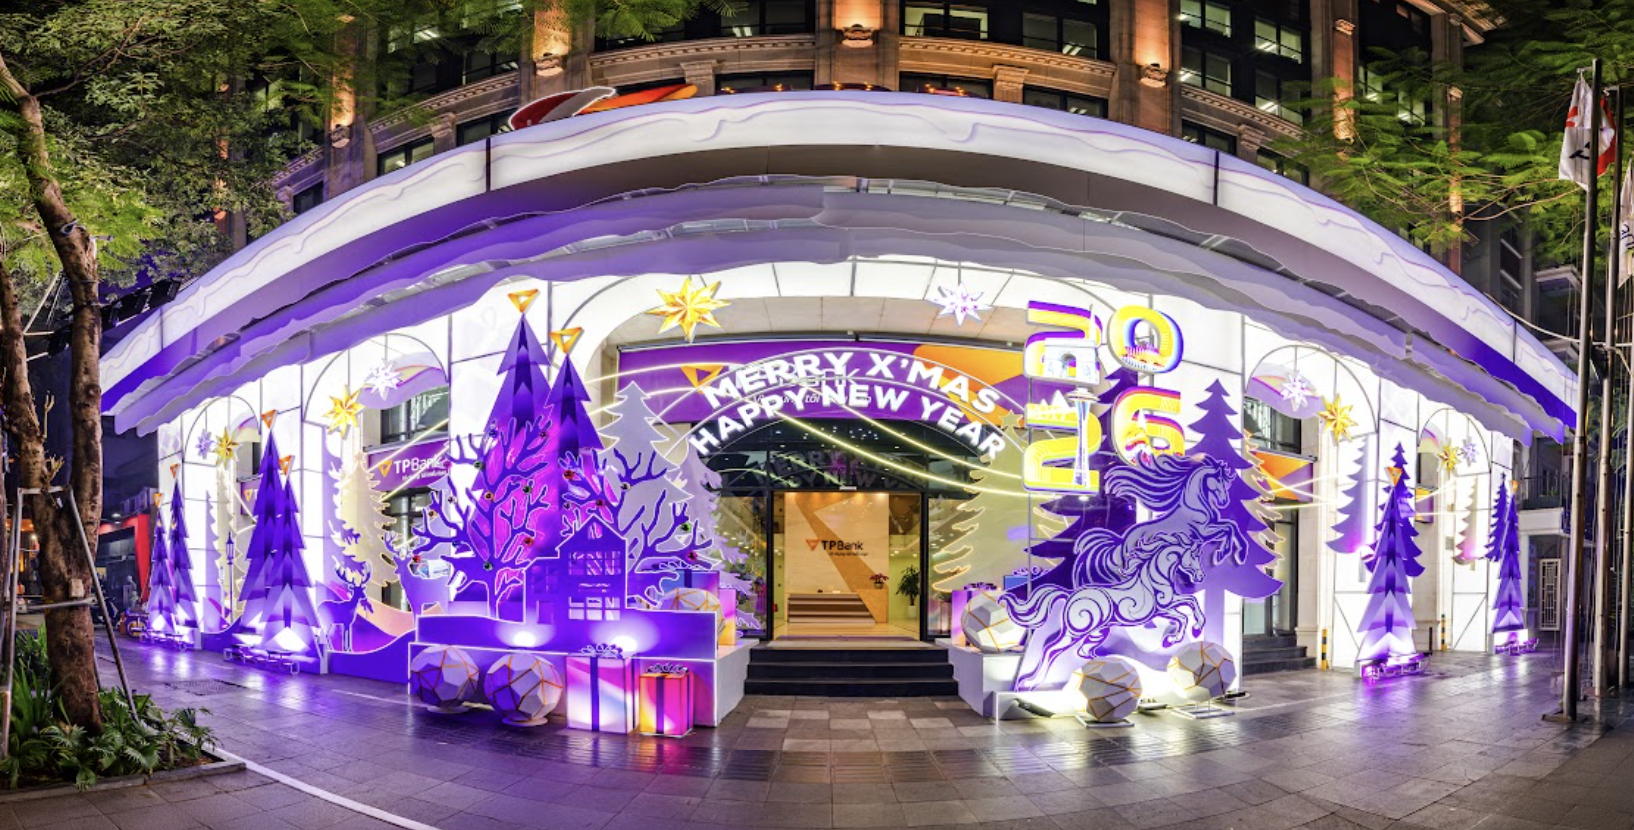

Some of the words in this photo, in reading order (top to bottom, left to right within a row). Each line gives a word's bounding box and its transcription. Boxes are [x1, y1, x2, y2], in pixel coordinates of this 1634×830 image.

[701, 351, 854, 410] MERRY
[688, 388, 808, 456] HAPPY
[821, 383, 910, 412] NEW
[920, 396, 1006, 461] YEAR
[393, 455, 443, 474] TPBank
[820, 539, 864, 551] TPBank
